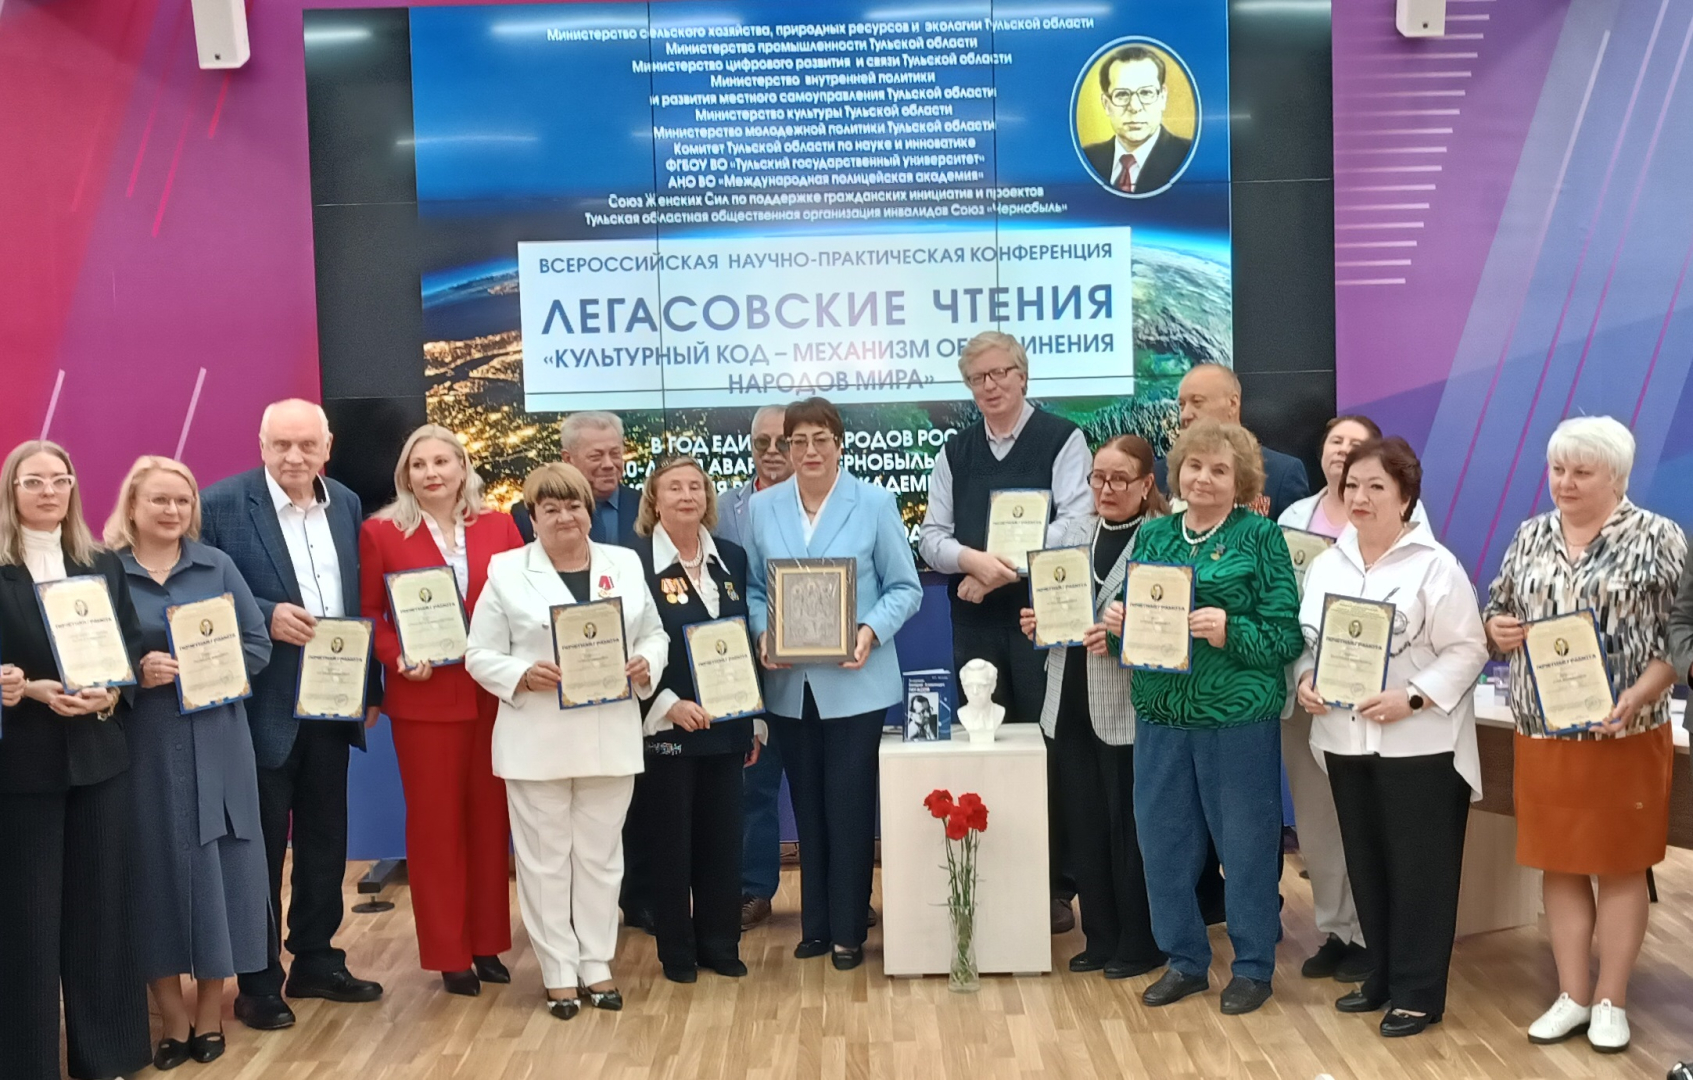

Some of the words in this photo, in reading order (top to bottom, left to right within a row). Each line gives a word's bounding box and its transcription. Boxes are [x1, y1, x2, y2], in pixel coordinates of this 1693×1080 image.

[547, 29, 637, 42] Министерство
[639, 27, 705, 39] сельского
[708, 24, 773, 38] хозяйства,
[776, 24, 845, 38] природных
[849, 23, 909, 36] ресурсов
[912, 22, 919, 32] и
[925, 21, 982, 32] экологии
[984, 18, 1040, 33] Тульской
[1042, 17, 1094, 30] области
[665, 43, 755, 57] Министерство
[758, 41, 867, 56] промышленности
[869, 38, 923, 53] Тульской
[926, 37, 977, 49] области
[632, 61, 723, 74] Министерство
[725, 59, 793, 73] цифрового
[796, 58, 851, 72] развития
[856, 58, 864, 68] и
[866, 57, 900, 67] связи
[902, 54, 957, 69] Тульской
[960, 52, 1012, 65] области
[710, 76, 800, 89] Министерство
[805, 72, 877, 88] внутренней
[878, 73, 935, 84] политики
[661, 94, 717, 108] развития
[719, 93, 777, 104] местного
[779, 91, 885, 105] самоуправления
[887, 88, 942, 103] Тульской
[944, 86, 996, 99] области
[695, 109, 785, 122] Министерство
[787, 108, 843, 121] культуры
[845, 105, 899, 120] Тульской
[901, 104, 953, 116] области
[653, 127, 742, 140] Министерство
[745, 123, 826, 138] молодежной
[828, 123, 885, 135] политики
[887, 120, 941, 136] Тульской
[944, 119, 996, 132] области
[673, 143, 725, 154] Комитет
[726, 141, 781, 156] Тульской
[784, 139, 835, 152] области
[838, 141, 852, 151] по
[855, 140, 892, 153] науке
[894, 140, 902, 150] и
[905, 138, 976, 150] инноватике
[666, 159, 707, 171] ФГБОУ
[710, 158, 728, 170] ВО
[792, 154, 900, 170] государственный
[668, 177, 696, 188] АНО
[698, 176, 716, 188] ВО
[831, 172, 913, 187] полицейская
[608, 196, 643, 208] Союз
[645, 195, 702, 207] Женских
[704, 194, 729, 206] Сил
[731, 195, 746, 205] по
[749, 193, 822, 206] поддержке
[824, 190, 907, 205] гражданских
[909, 189, 973, 202] инициатив
[975, 188, 983, 198] и
[986, 187, 1043, 201] проектов
[584, 212, 640, 226] Тульская
[642, 209, 708, 223] областная
[711, 207, 800, 223] общественная
[803, 207, 881, 221] организация
[883, 205, 948, 218] инвалидов
[951, 203, 984, 215] Союз
[539, 252, 719, 274] ВСЕРОССИЙСКАЯ
[729, 247, 965, 269] НАУЧНО-ПРАКТИЧЕСКАЯ
[971, 242, 1112, 262] КОНФЕРЕНЦИЯ
[541, 290, 905, 335] ЛЕГАСОВСКИЕ
[933, 284, 1112, 323] ЧТЕНИЯ
[543, 341, 709, 369] «КУЛЬТУРНЫЙ
[717, 344, 769, 366] КОД
[793, 339, 929, 362] МЕХАНИЗМ
[729, 371, 849, 396] НАРОДОВ
[856, 369, 934, 391] МИРА»
[651, 436, 662, 454] В
[668, 436, 709, 457] ГОД
